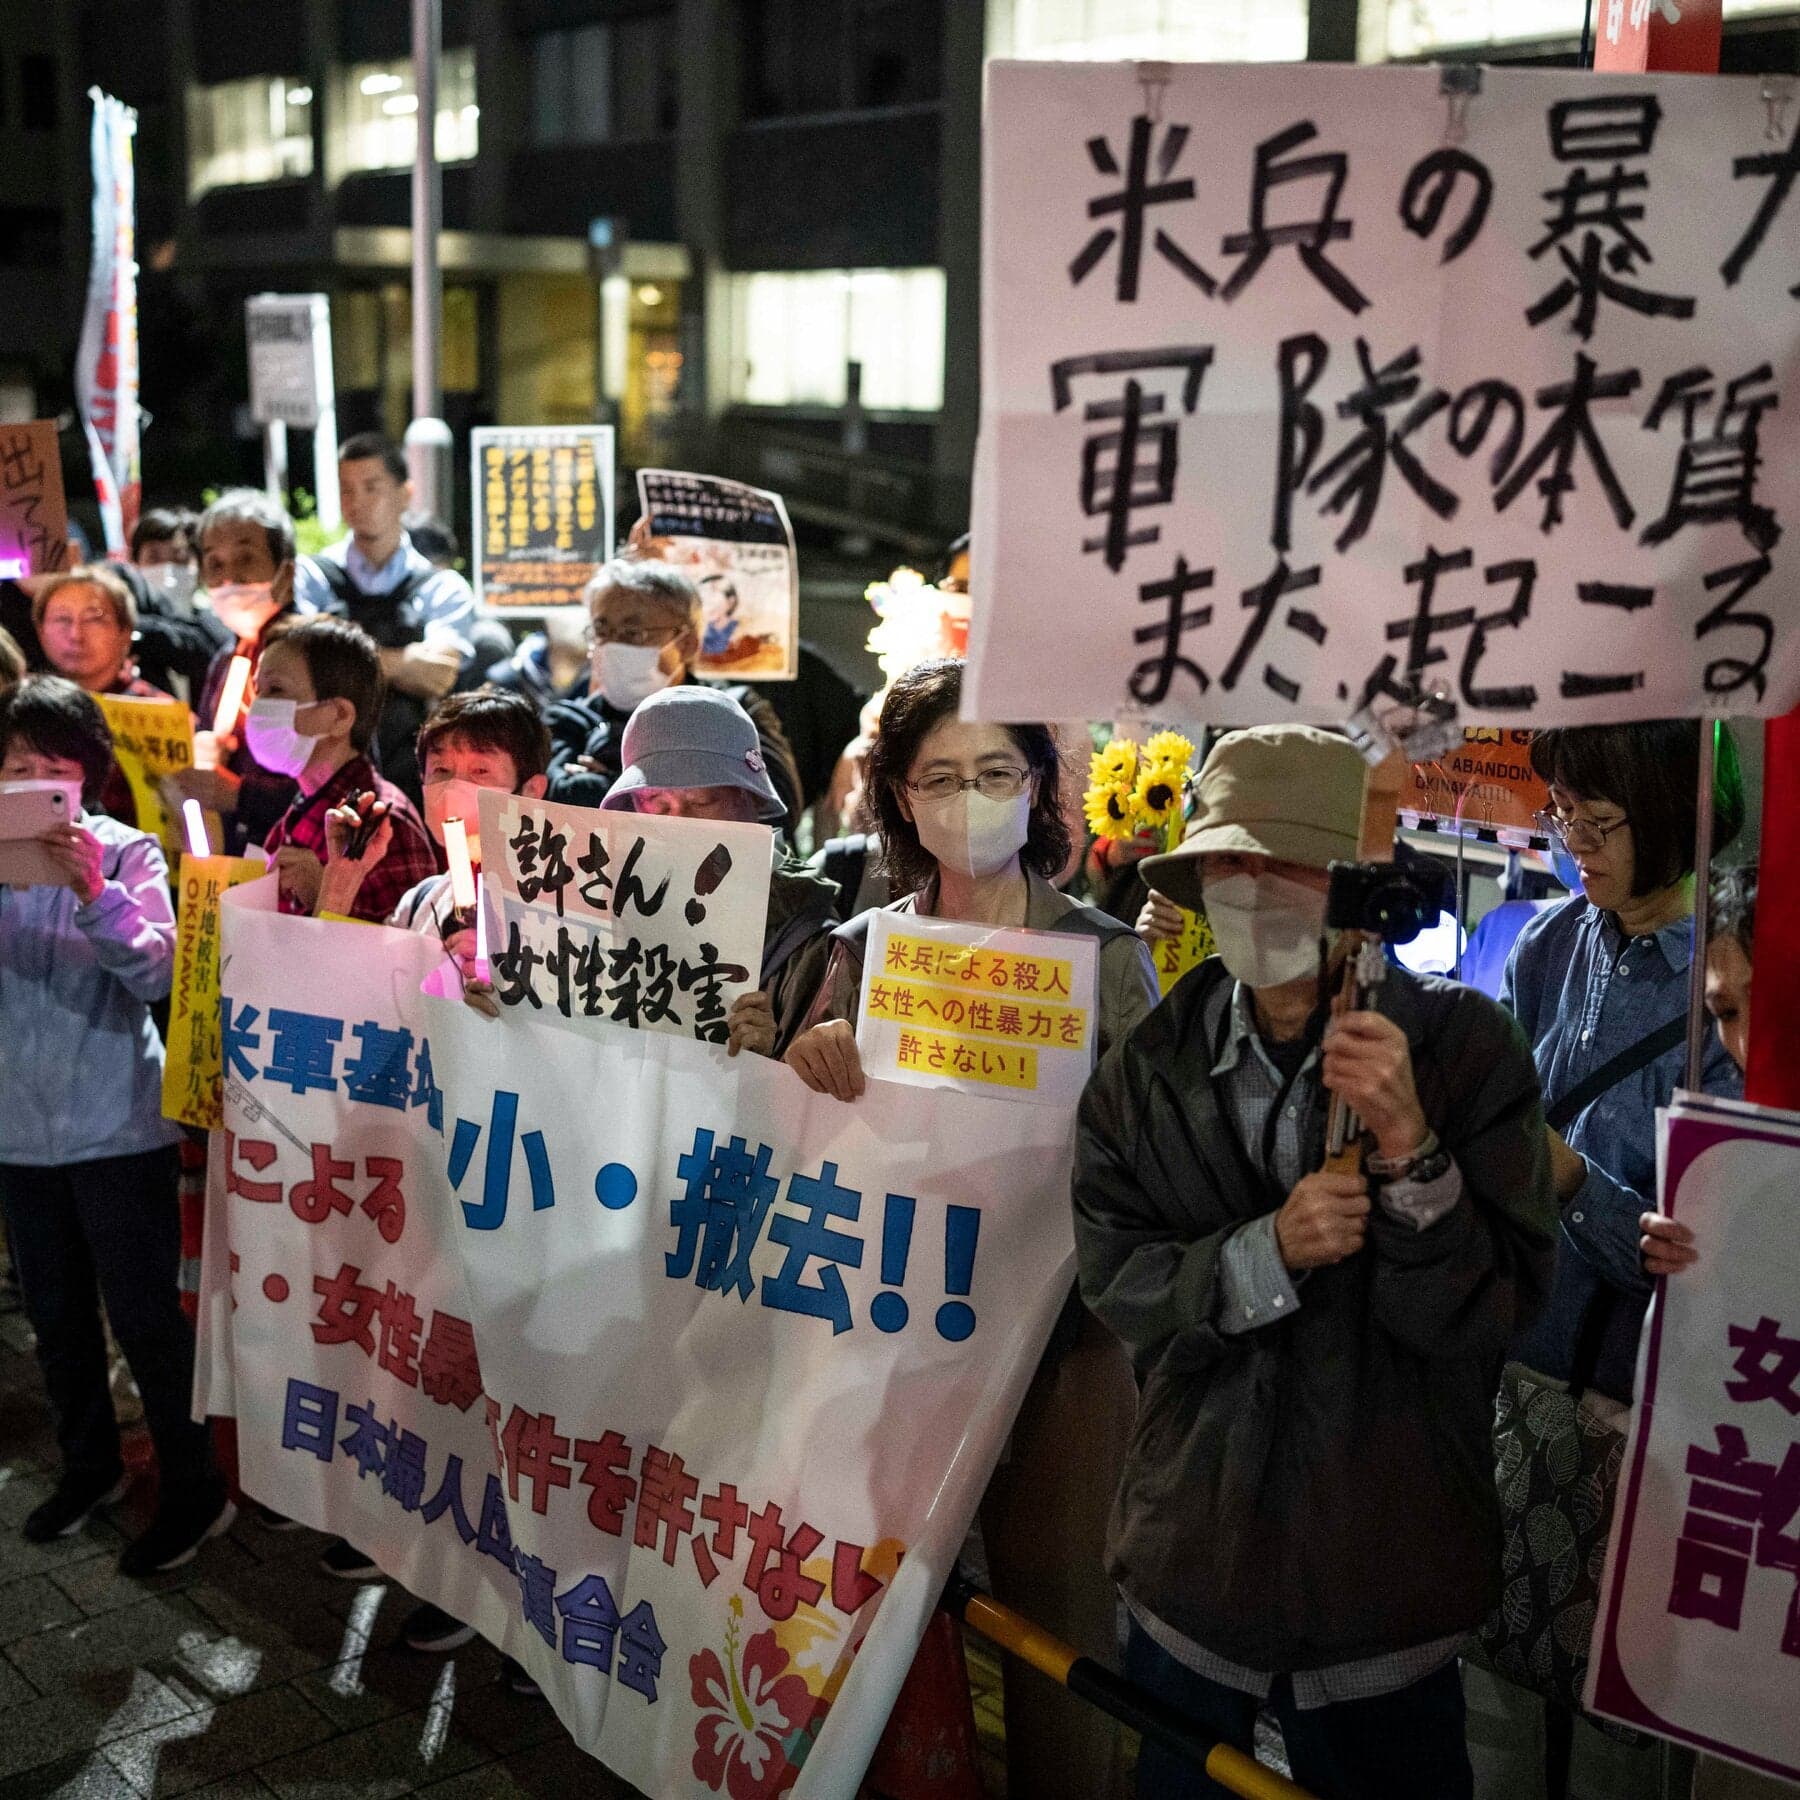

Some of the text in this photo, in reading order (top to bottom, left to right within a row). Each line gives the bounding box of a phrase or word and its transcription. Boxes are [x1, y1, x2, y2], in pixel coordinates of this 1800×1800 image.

[1051, 332, 1782, 571] 軍隊の本質
[1127, 546, 1775, 716] また起こる
[1452, 757, 1533, 782] ABANDON
[509, 814, 732, 927] 許さん!
[178, 877, 200, 1020] OKINAWA
[491, 920, 750, 1045] 女性殺害
[886, 941, 1069, 995] 米兵による殺人
[869, 983, 1083, 1044] 女性への性暴力を
[898, 1034, 1026, 1080] 許さない!
[224, 1128, 406, 1244] による
[230, 1250, 485, 1413] ・女性暴
[485, 1394, 905, 1622] 件を許さない
